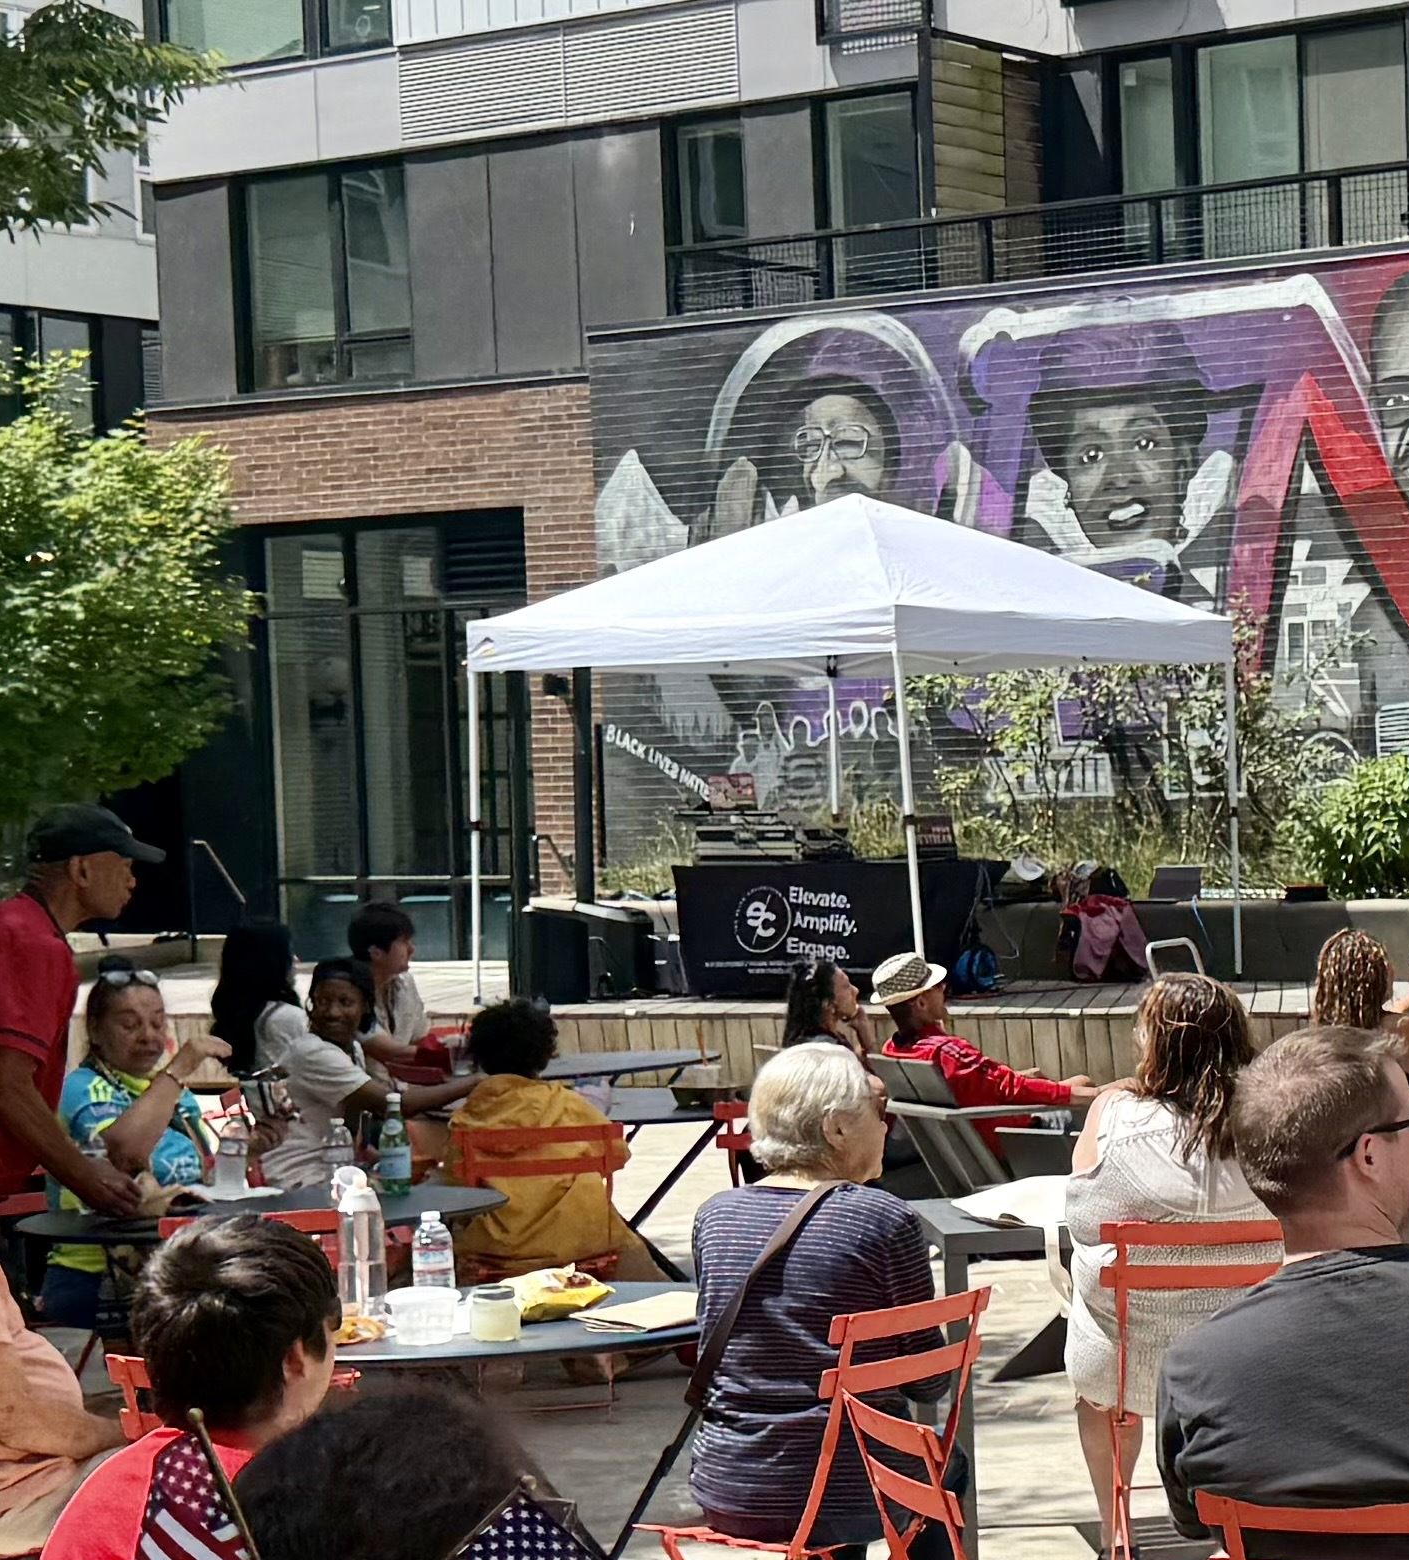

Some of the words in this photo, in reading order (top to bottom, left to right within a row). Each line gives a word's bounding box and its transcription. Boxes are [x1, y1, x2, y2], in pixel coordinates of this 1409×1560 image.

[606, 724, 647, 760] BLACK
[679, 767, 711, 802] MATTE
[789, 886, 851, 909] Elevate.
[793, 911, 858, 937] Amplify.
[786, 936, 850, 962] Engage.
